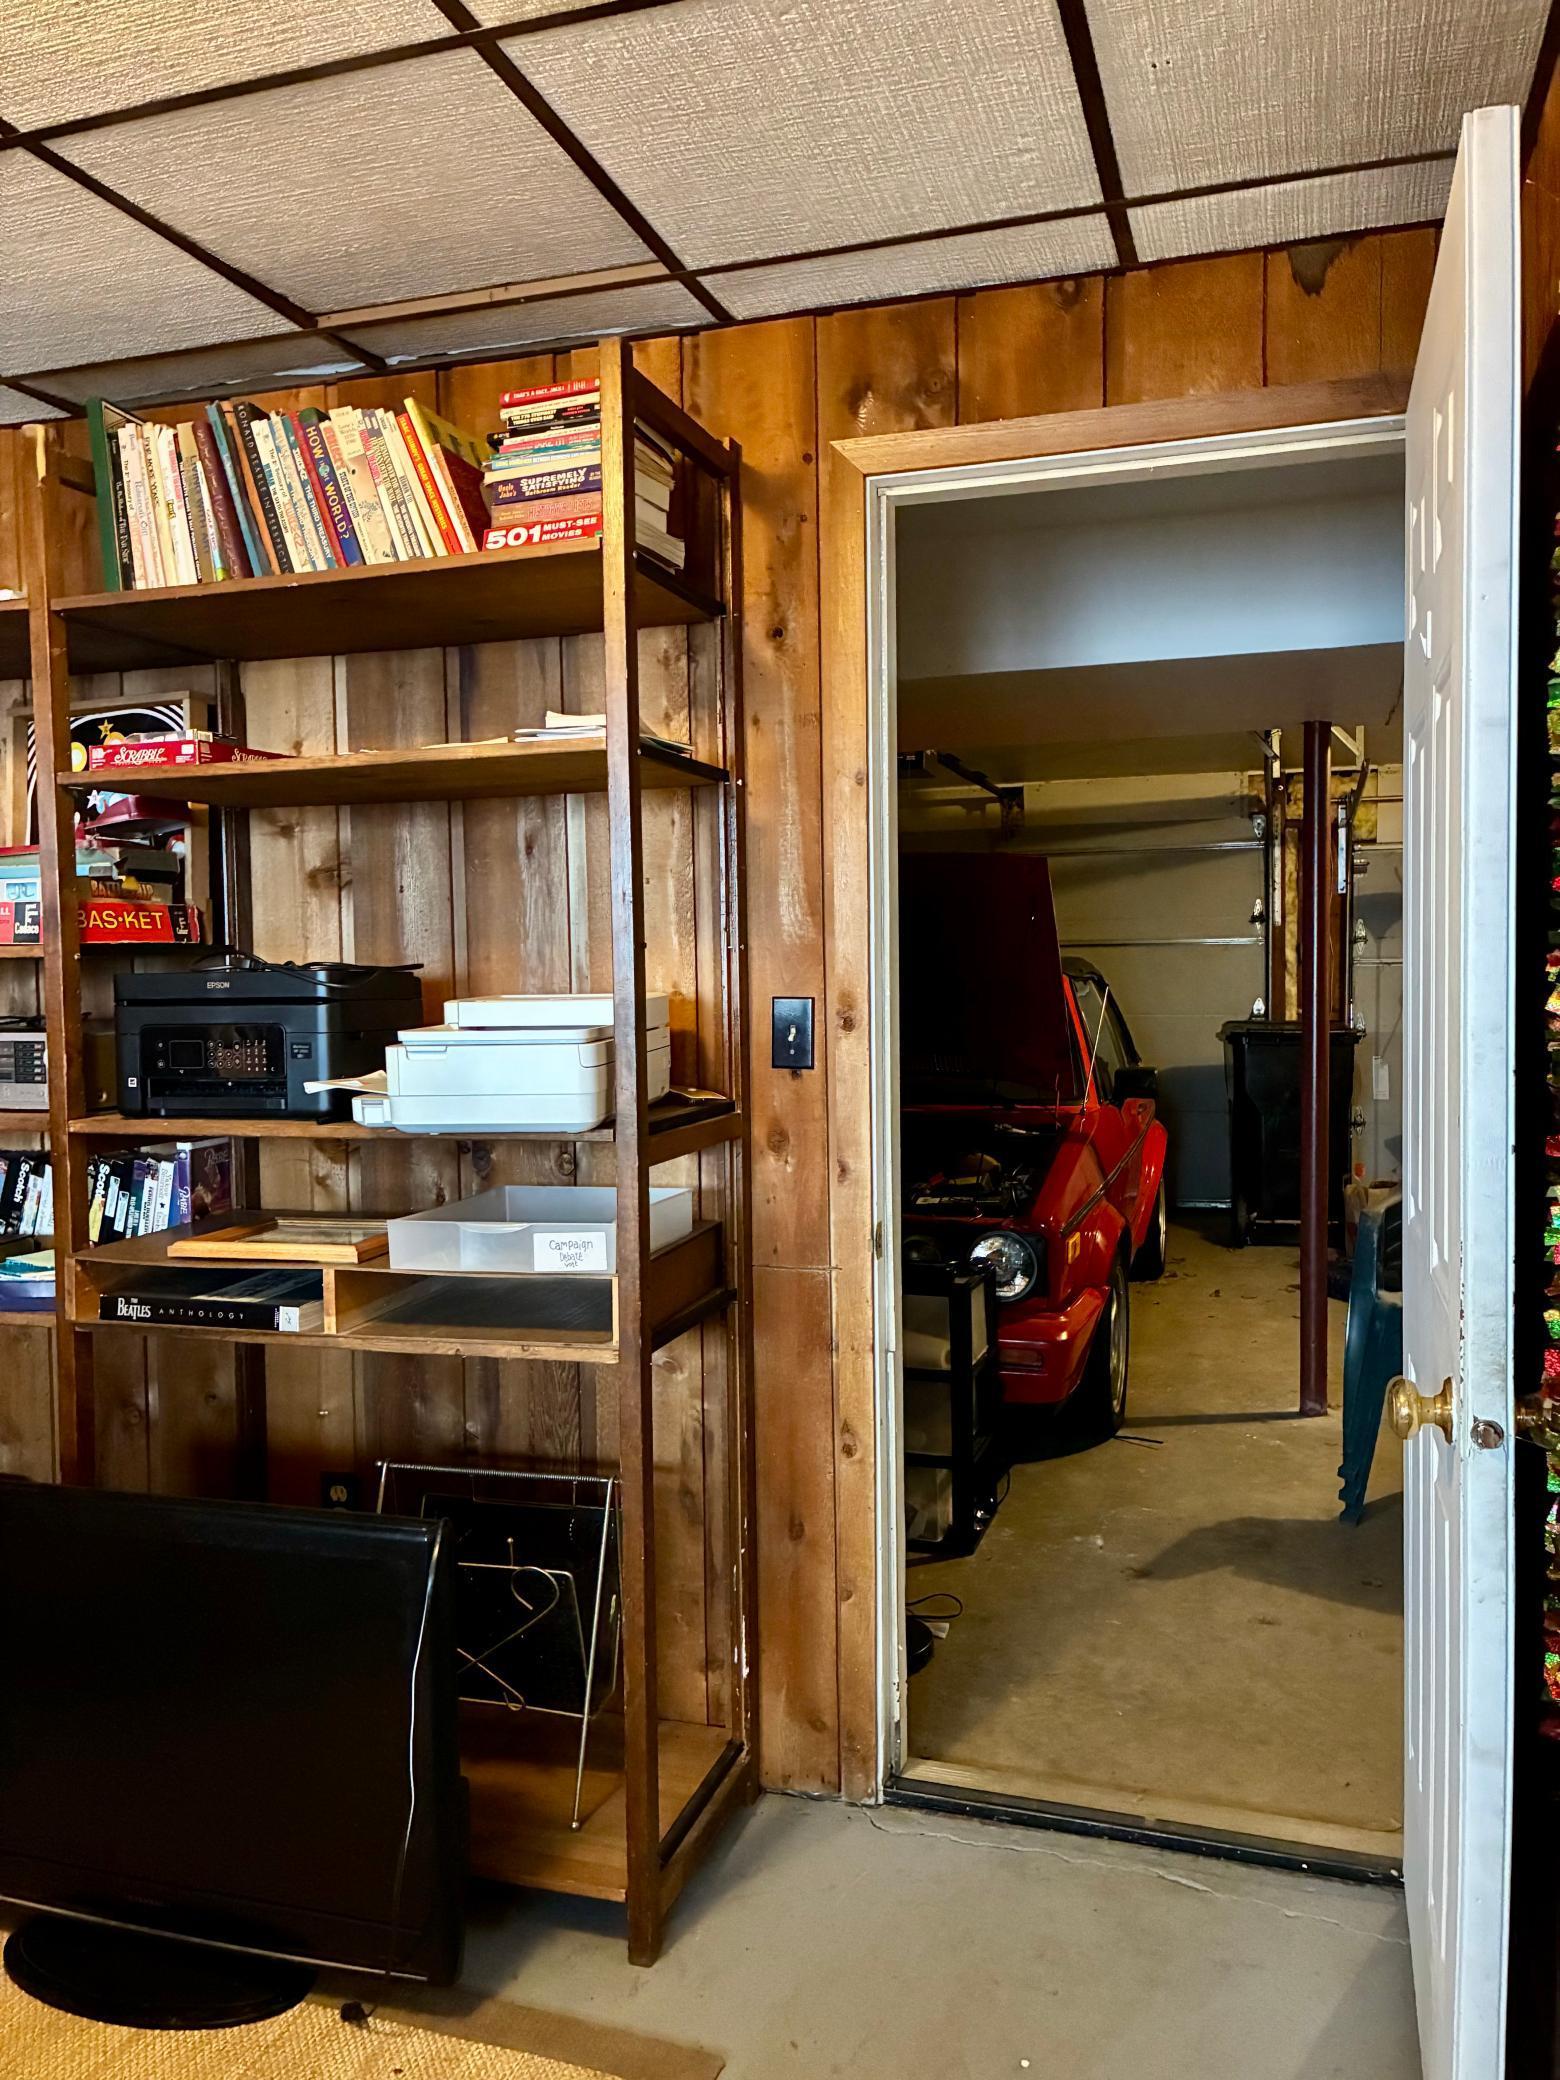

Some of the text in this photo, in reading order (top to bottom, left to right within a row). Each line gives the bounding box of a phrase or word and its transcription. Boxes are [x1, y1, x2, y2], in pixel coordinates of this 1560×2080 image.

[237, 405, 255, 449] RONALD
[249, 453, 268, 493] SEARLE
[263, 497, 271, 509] IN
[304, 425, 325, 460] HOW
[325, 482, 350, 539] WORLD?
[398, 416, 410, 434] ISAAC
[415, 461, 429, 481] GREAT
[423, 480, 436, 500] SPACE
[430, 498, 448, 530] MYSTERIES
[518, 467, 587, 487] SUPREMELY
[520, 475, 586, 492] SATISFYING
[524, 485, 556, 497] Bathroom
[303, 484, 313, 500] THE
[308, 499, 321, 522] THIRD
[315, 522, 332, 559] TREASURY
[483, 516, 598, 550] 501 MUST-SEE
[540, 528, 582, 541] MOVIES
[114, 746, 166, 764] SCRABBLE
[206, 981, 230, 989] EPSON
[12, 1161, 31, 1203] Scotch
[92, 1162, 111, 1199] Scot
[549, 1239, 593, 1252] Campaign
[116, 1297, 244, 1320] BEATLES ANTHOLOGY
